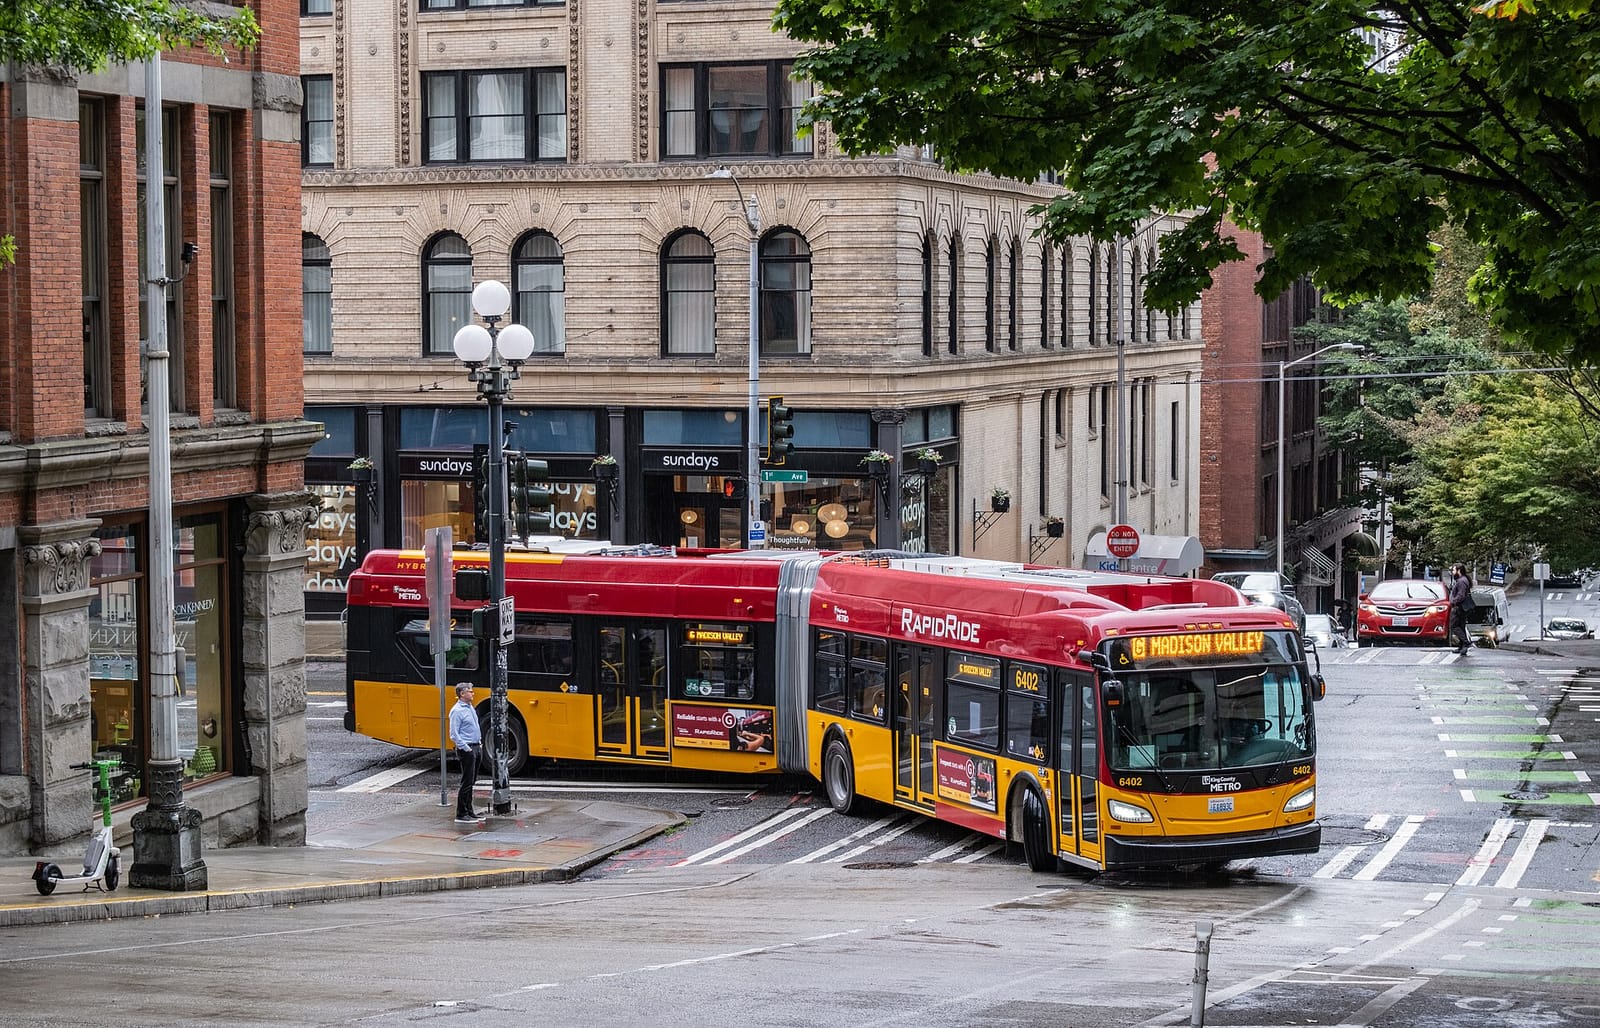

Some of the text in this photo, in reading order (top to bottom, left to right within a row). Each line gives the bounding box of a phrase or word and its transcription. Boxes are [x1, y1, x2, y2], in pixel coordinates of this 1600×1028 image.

[420, 458, 473, 475] sundays
[663, 452, 719, 470] sundays
[765, 471, 774, 480] 1st
[902, 497, 926, 527] ndays
[308, 505, 356, 536] days
[549, 504, 597, 536] days
[770, 536, 811, 545] Thoughtfully
[306, 539, 357, 569] days
[396, 562, 426, 570] HYBR
[1130, 564, 1158, 573] entre
[398, 592, 422, 601] METRO
[186, 598, 216, 613] KENNEDY
[501, 601, 513, 613] ONE
[501, 613, 513, 625] WAY
[696, 631, 722, 640] MADISON
[722, 632, 744, 641] VALLEY
[1133, 631, 1263, 656] G MADISON VALLEY
[1015, 669, 1039, 691] 6402
[676, 713, 696, 721] Reliable
[1292, 765, 1311, 775] 6402
[1119, 777, 1142, 786] 6402
[1210, 782, 1242, 792] METRO
